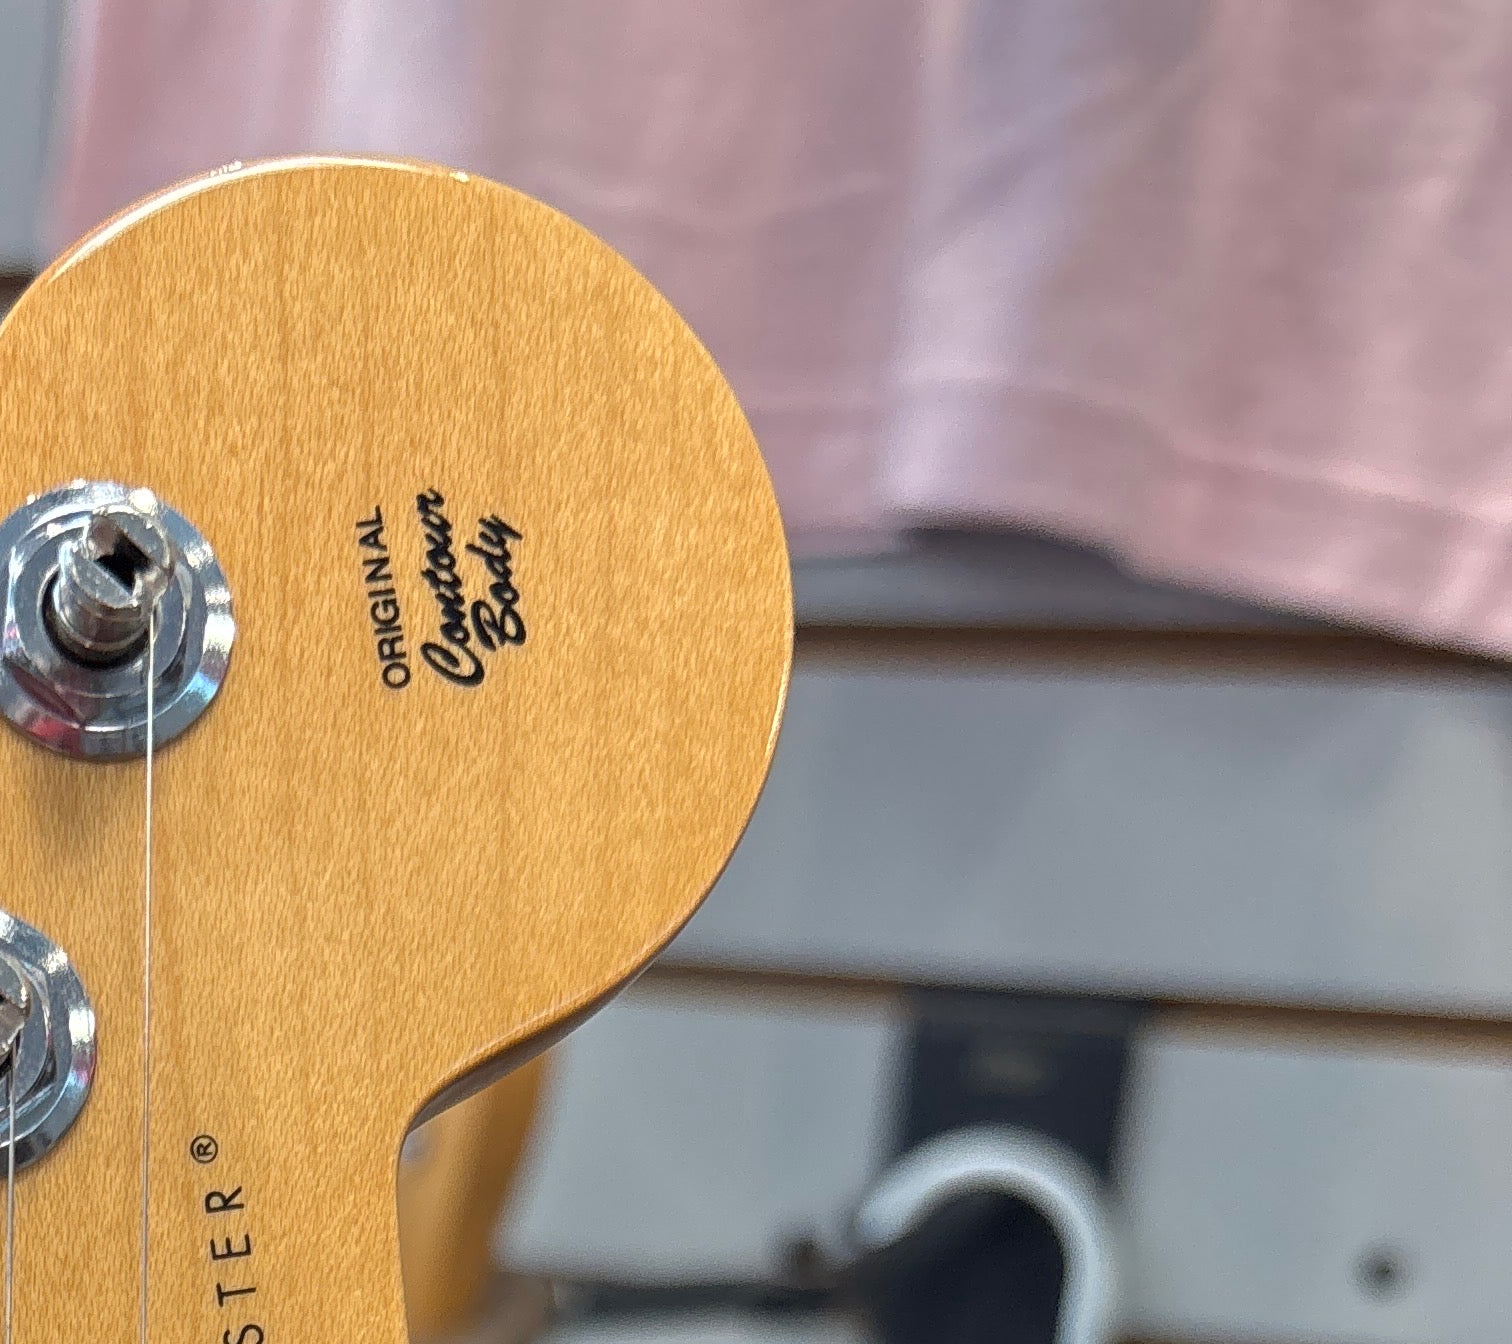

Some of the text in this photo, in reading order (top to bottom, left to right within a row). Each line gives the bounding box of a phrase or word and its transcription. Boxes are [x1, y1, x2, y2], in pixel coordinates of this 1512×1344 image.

[356, 504, 411, 690] ORIGINAL
[416, 487, 485, 688] Contour
[465, 513, 527, 651] Body
